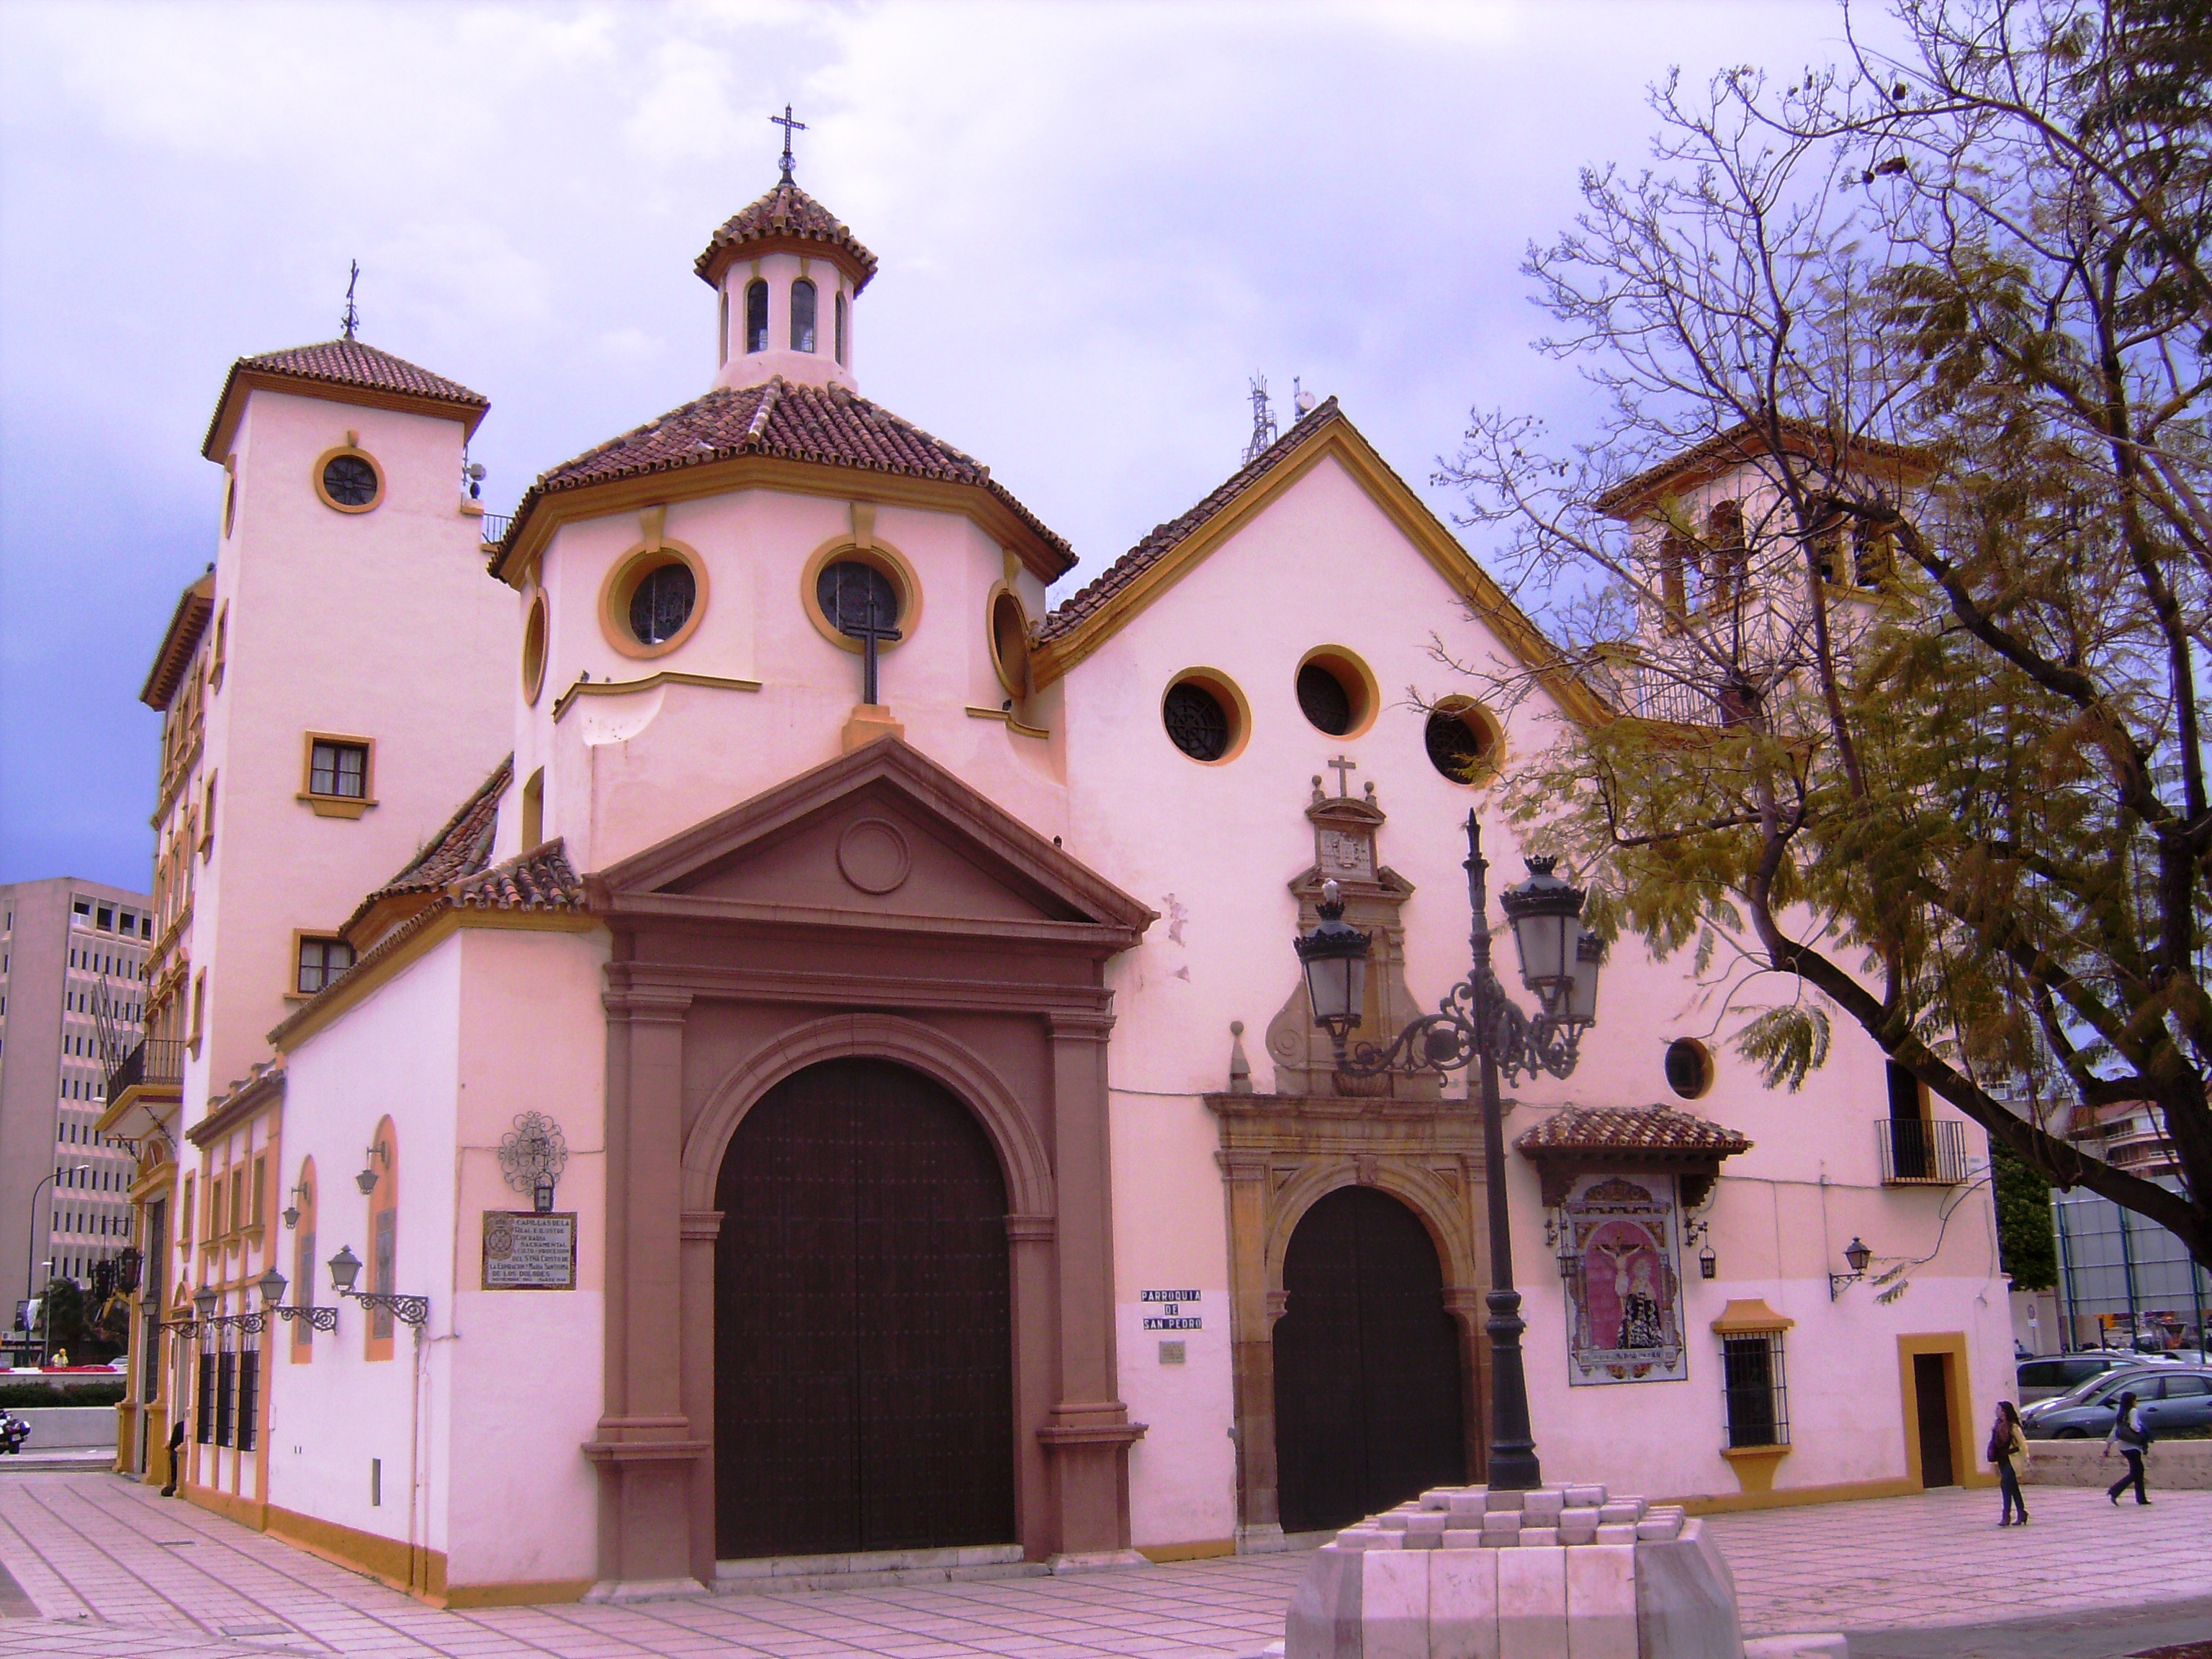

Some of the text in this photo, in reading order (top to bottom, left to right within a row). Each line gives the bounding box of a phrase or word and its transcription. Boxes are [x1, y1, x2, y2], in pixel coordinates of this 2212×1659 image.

[1141, 1290, 1201, 1301] PARROQUIA
[1165, 1305, 1178, 1315] DE
[1143, 1318, 1202, 1329] SAN PEDRO
